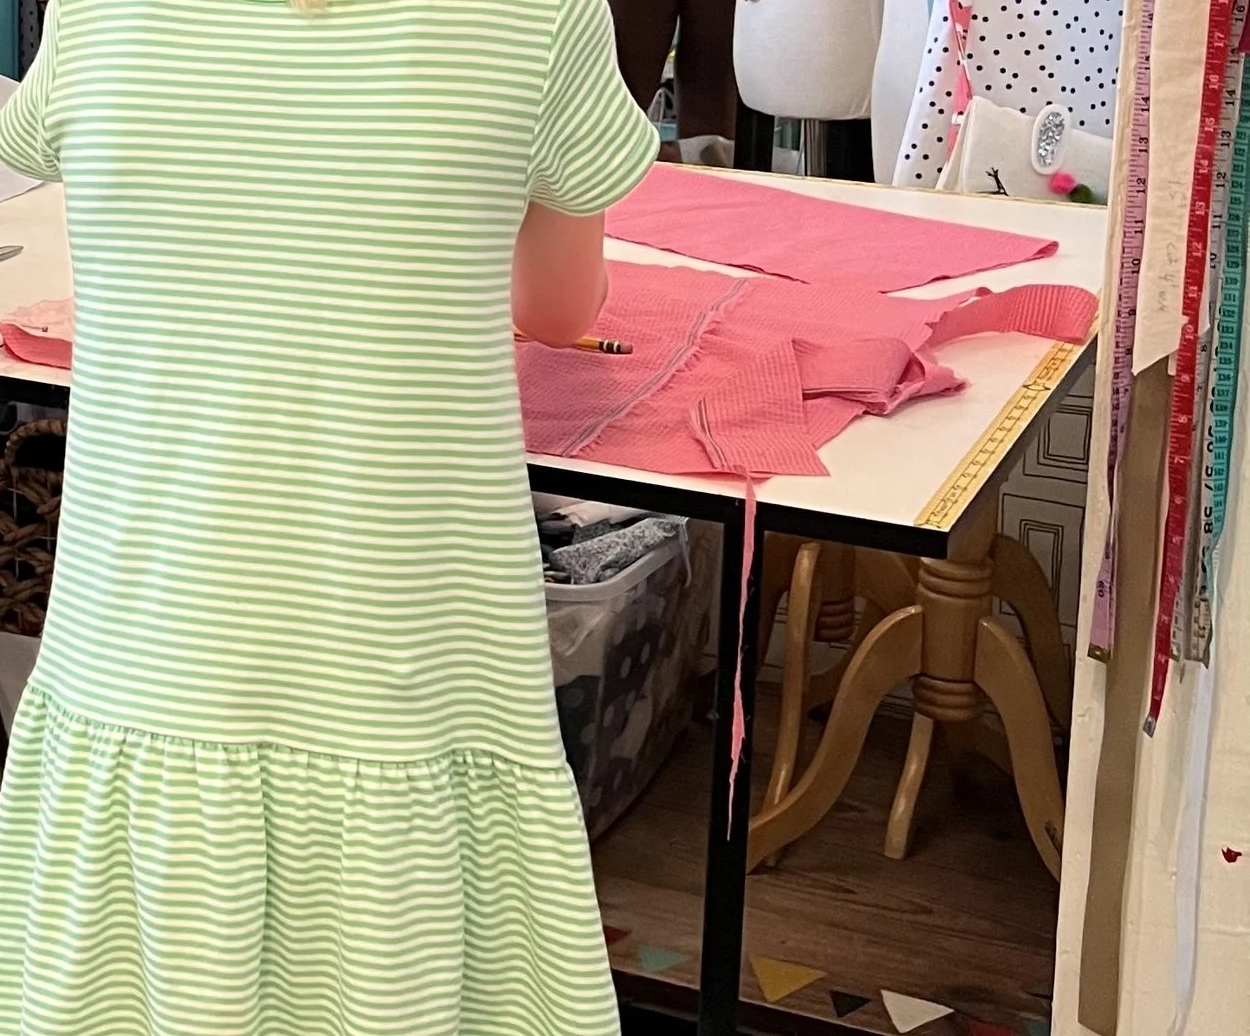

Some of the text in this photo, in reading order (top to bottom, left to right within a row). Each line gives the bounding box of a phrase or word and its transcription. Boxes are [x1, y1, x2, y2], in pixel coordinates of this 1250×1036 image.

[1233, 4, 1246, 22] 16
[1213, 31, 1225, 48] 17
[1140, 96, 1150, 113] 14
[1225, 89, 1236, 106] 14
[1138, 136, 1149, 154] 13
[1220, 130, 1232, 147] 13
[1136, 177, 1146, 194] 12
[1216, 171, 1227, 188] 12
[1195, 200, 1206, 216] 13
[1134, 218, 1144, 235] 11
[1212, 213, 1223, 229] 11
[1191, 241, 1202, 258] 12
[1131, 258, 1141, 275] 10
[1184, 324, 1194, 340] 10
